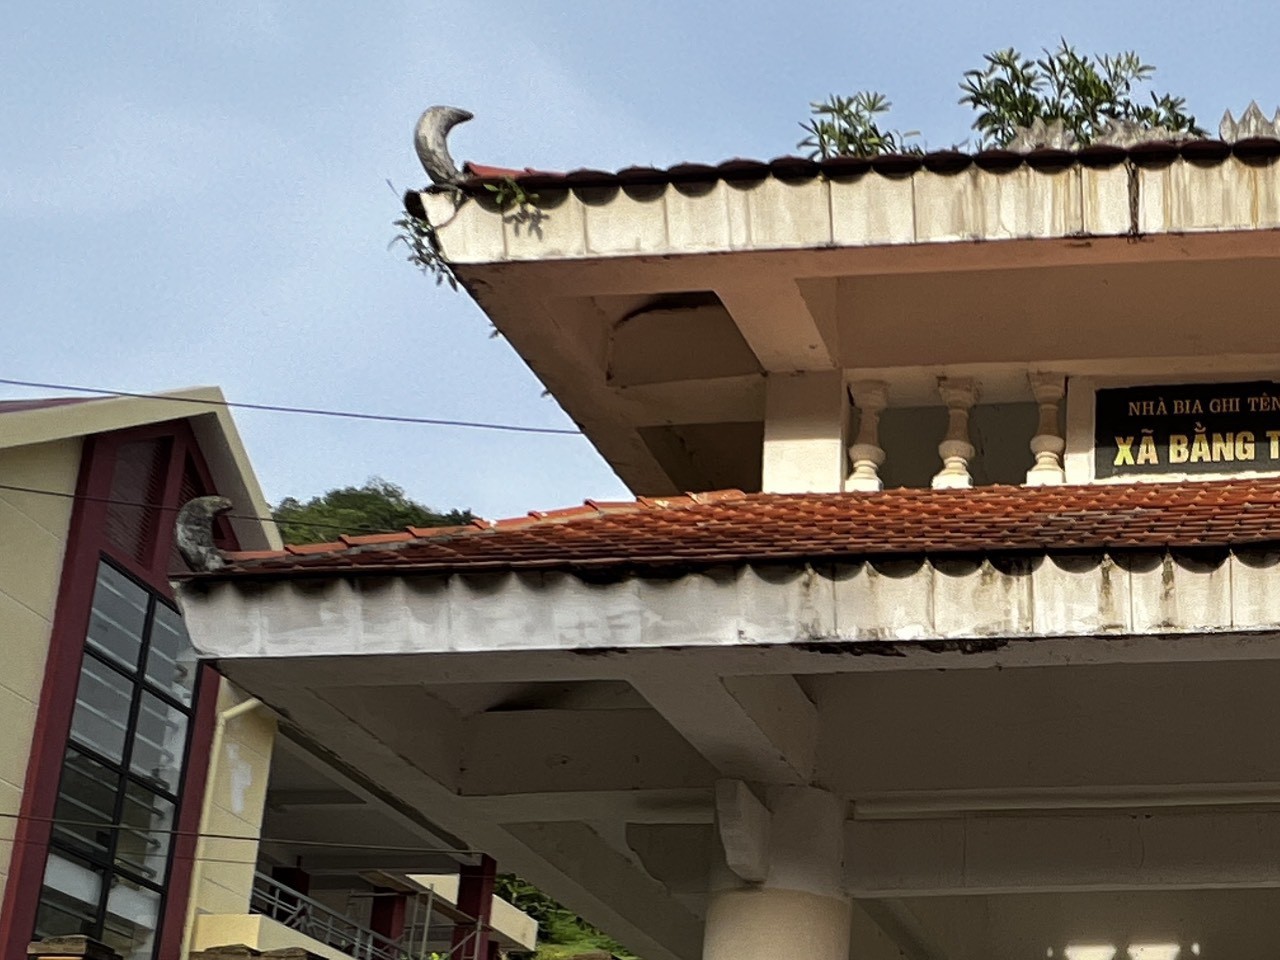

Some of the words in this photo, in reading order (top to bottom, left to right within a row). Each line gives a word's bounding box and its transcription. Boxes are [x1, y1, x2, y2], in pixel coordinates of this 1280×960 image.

[1128, 396, 1168, 416] NHÀ
[1173, 399, 1204, 414] BIA
[1209, 397, 1240, 413] GHI
[1113, 428, 1159, 466] XÃ
[1168, 421, 1256, 464] BẰNG
